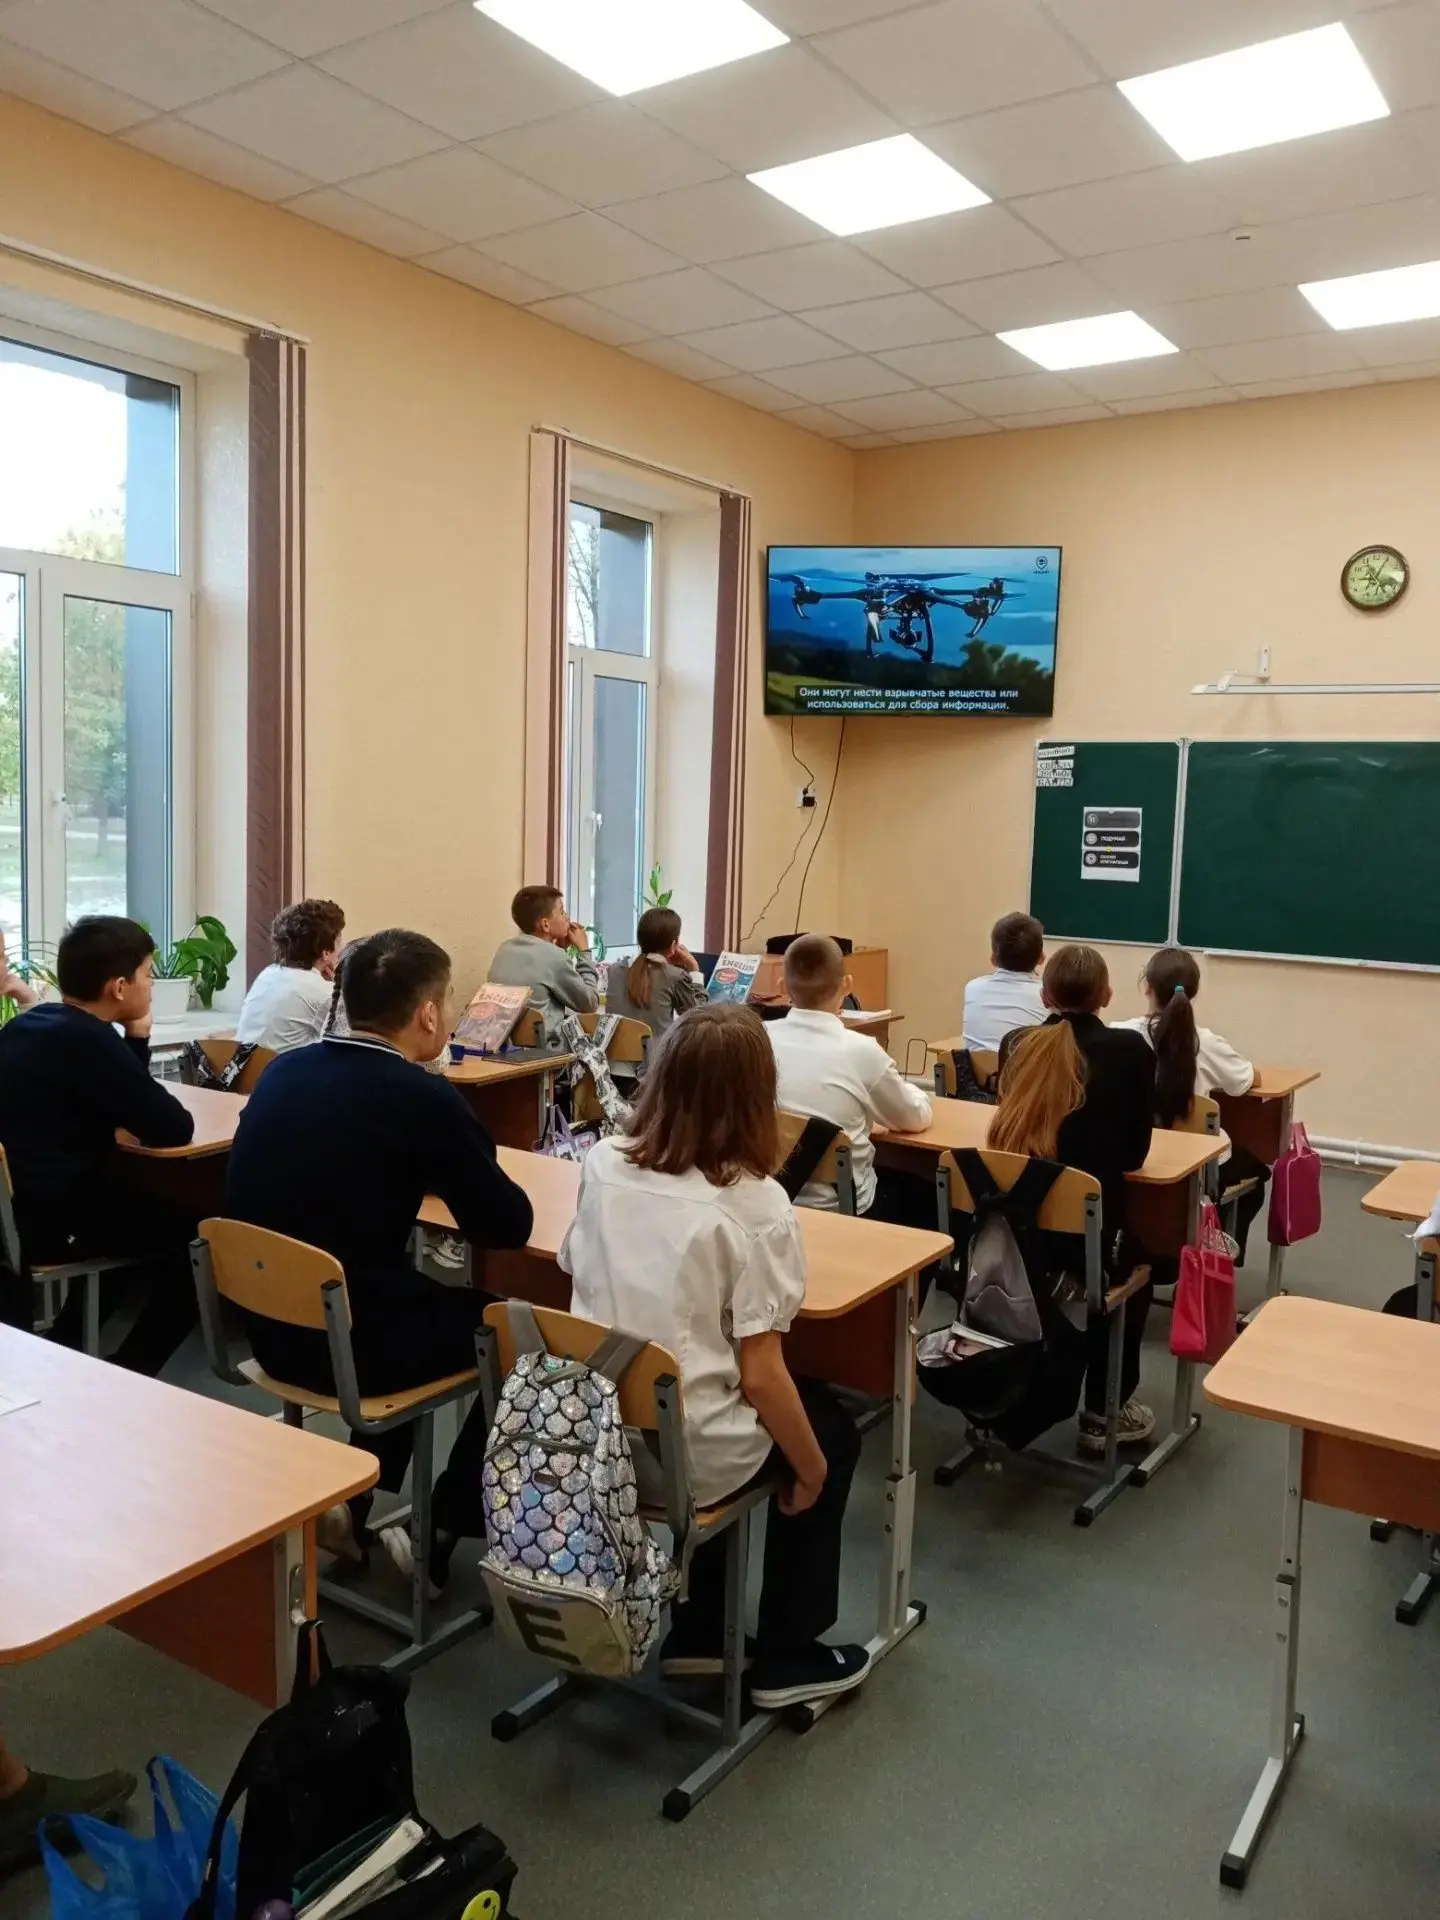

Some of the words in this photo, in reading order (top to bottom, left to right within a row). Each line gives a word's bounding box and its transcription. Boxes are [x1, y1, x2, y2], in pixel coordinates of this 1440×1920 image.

[799, 687, 820, 697] Они
[822, 689, 852, 699] могут
[853, 689, 882, 698] нести
[884, 689, 946, 698] взрывчатые
[948, 689, 997, 699] вещества
[999, 689, 1018, 698] или
[807, 700, 886, 709] использоваться
[888, 701, 907, 710] для
[909, 700, 939, 710] сбора
[942, 701, 1010, 711] информации.
